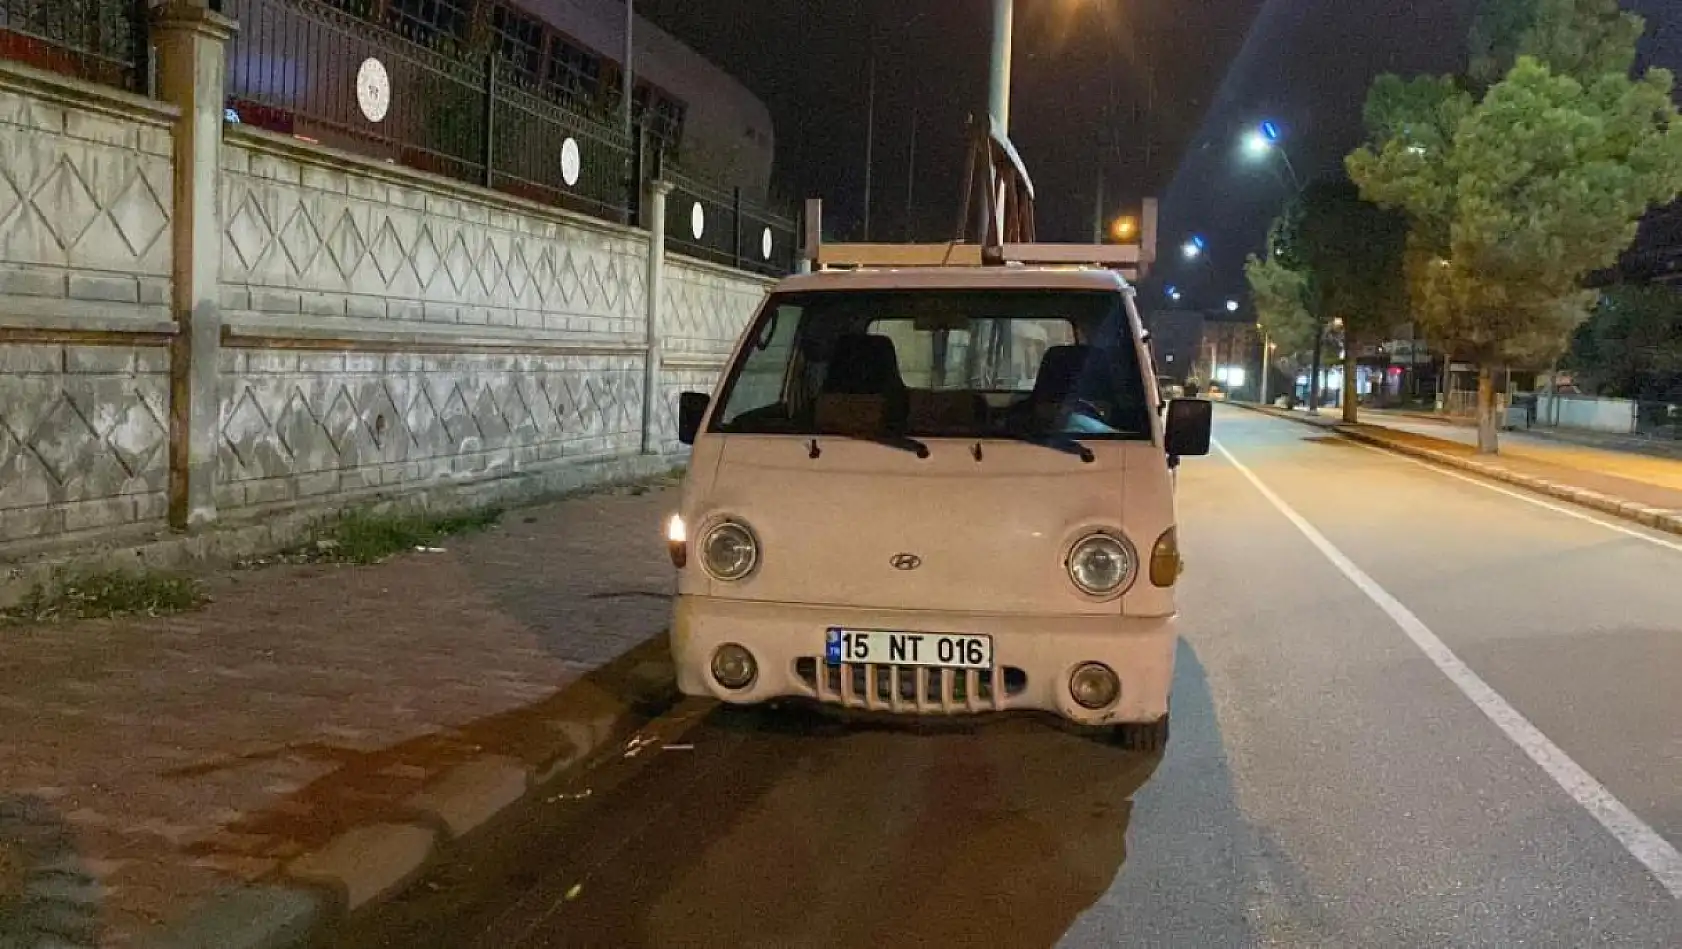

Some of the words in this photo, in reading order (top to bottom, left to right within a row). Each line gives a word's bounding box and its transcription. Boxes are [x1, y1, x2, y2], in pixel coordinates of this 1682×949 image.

[842, 633, 869, 658] 15
[889, 634, 924, 661] NT
[937, 637, 983, 665] 016
